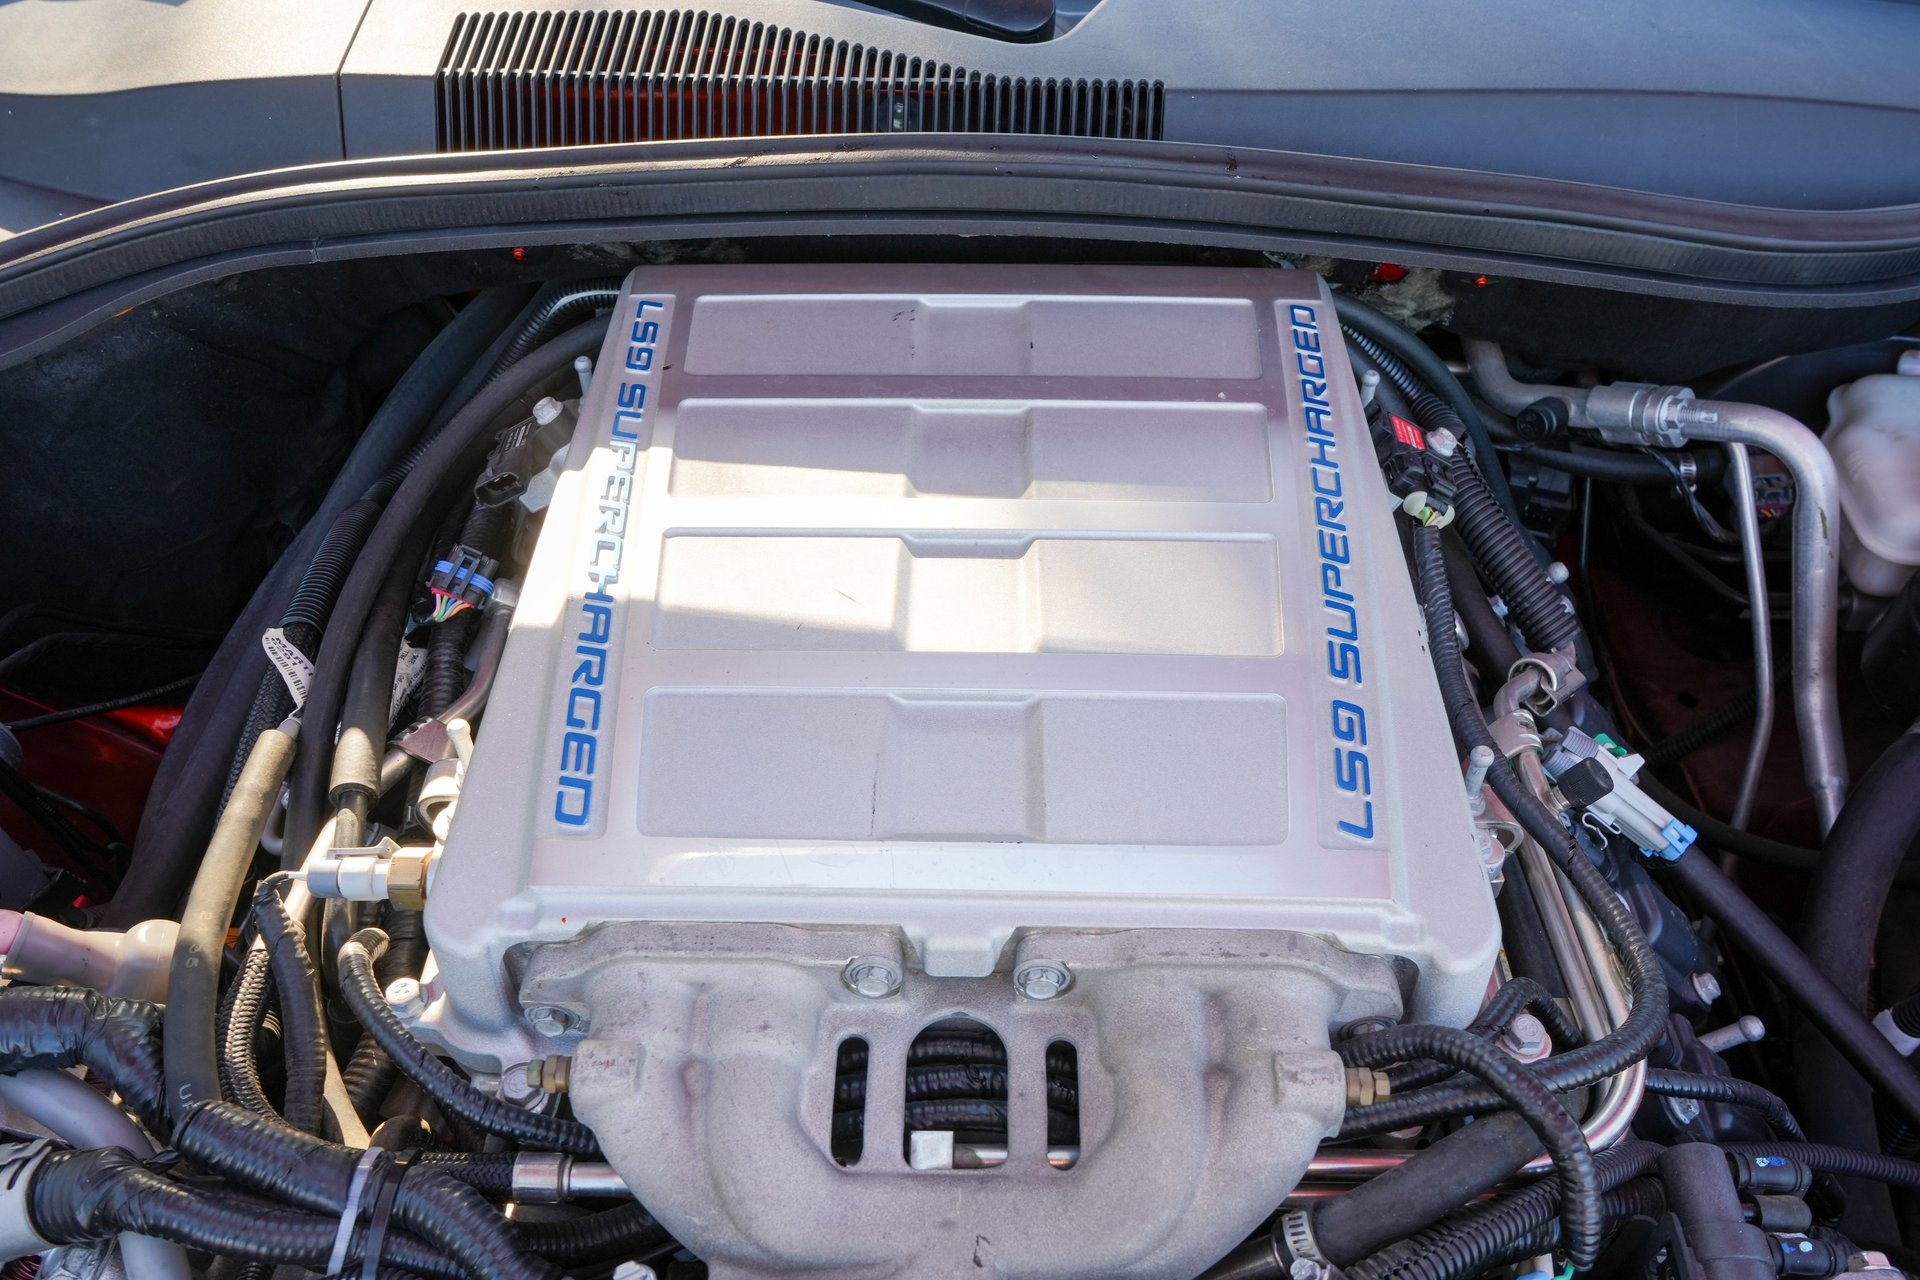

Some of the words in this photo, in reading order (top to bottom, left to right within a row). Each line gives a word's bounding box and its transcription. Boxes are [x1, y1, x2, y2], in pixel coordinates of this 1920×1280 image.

[626, 300, 664, 371] LS9
[556, 382, 646, 826] SUPERCHARGED
[1289, 303, 1362, 684] SUPERCHARGED
[1332, 699, 1375, 839] LS9
